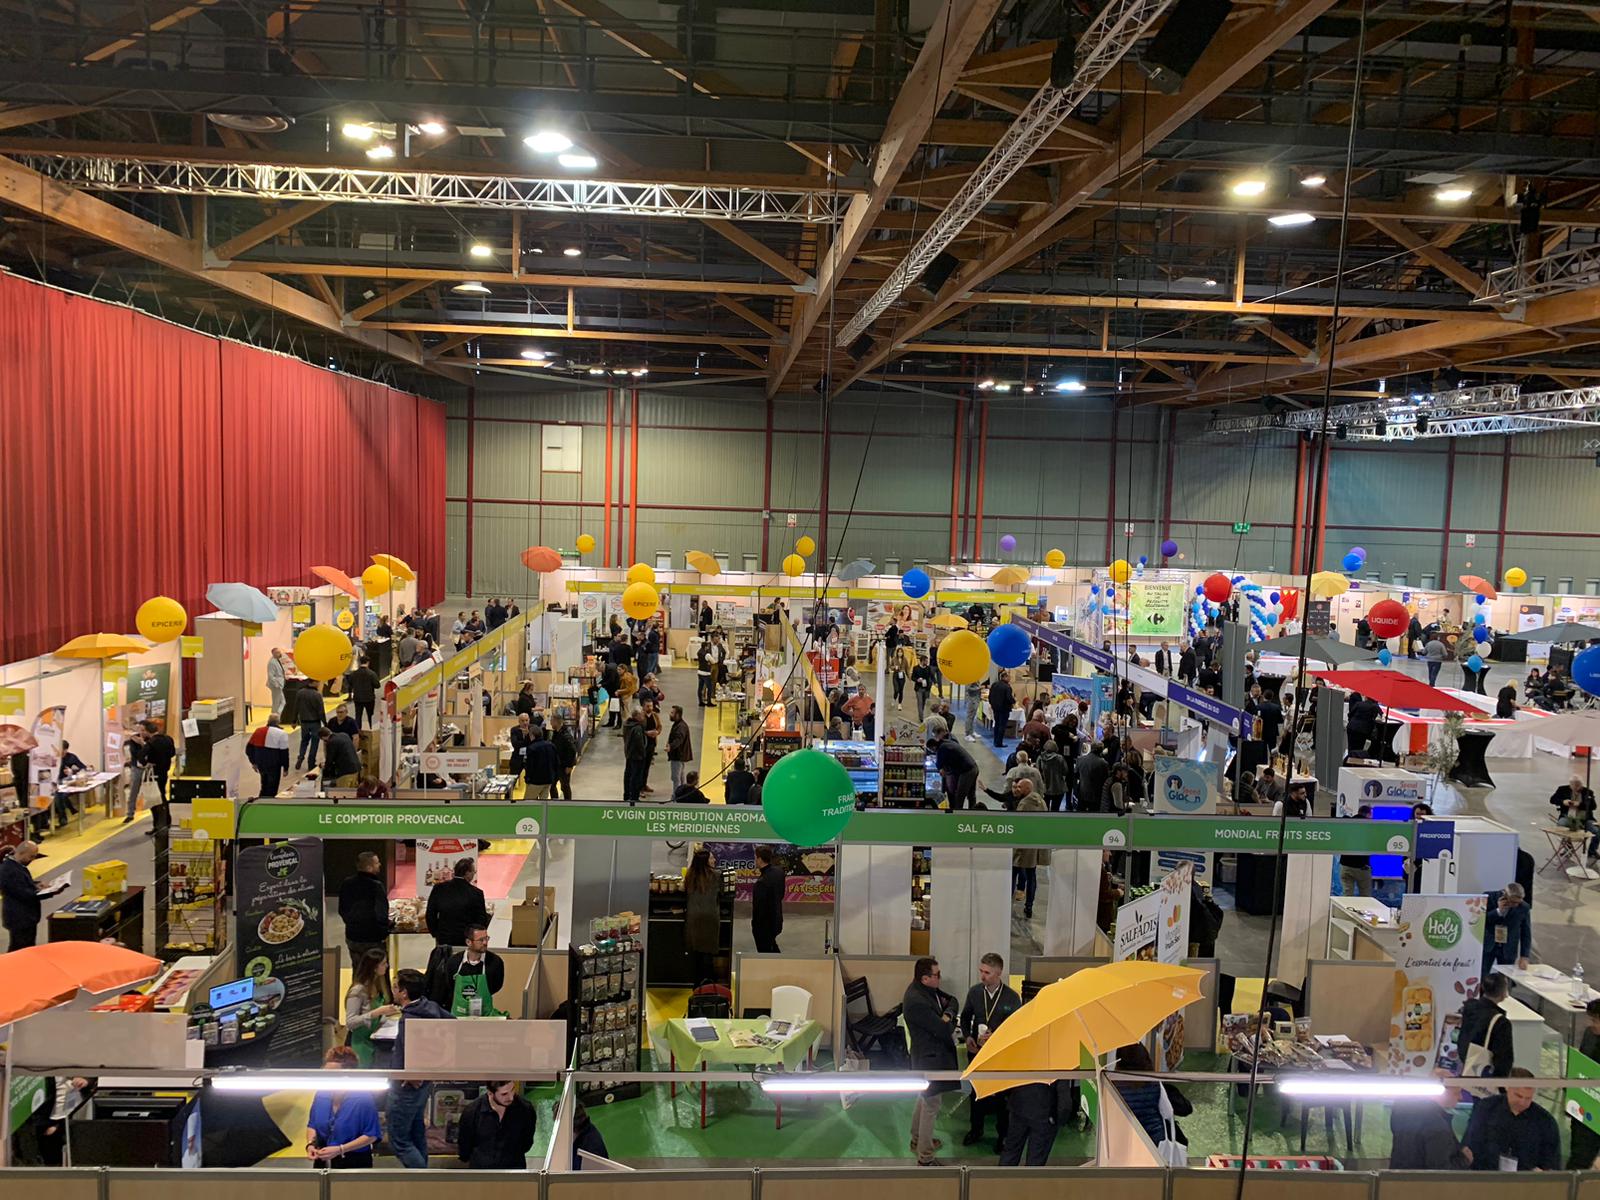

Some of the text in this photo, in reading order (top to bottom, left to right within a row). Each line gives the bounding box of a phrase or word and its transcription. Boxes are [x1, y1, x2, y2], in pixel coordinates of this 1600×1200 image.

[139, 679, 158, 690] 100
[319, 814, 464, 825] LE COMPTOIR PROVENCAL
[601, 810, 767, 823] JC VIGIN DISTRIBUTION AROMA
[522, 824, 533, 832] 92
[646, 823, 740, 834] LES MERIDIENNES
[957, 824, 1014, 834] SAL FA DIS
[1108, 836, 1119, 844] 94
[1215, 829, 1331, 841] MONDIAL FRUITS SECS
[1392, 841, 1403, 850] 95
[720, 860, 755, 870] ENERG
[1120, 917, 1158, 947] SALFADIS
[1428, 917, 1458, 943] Holy
